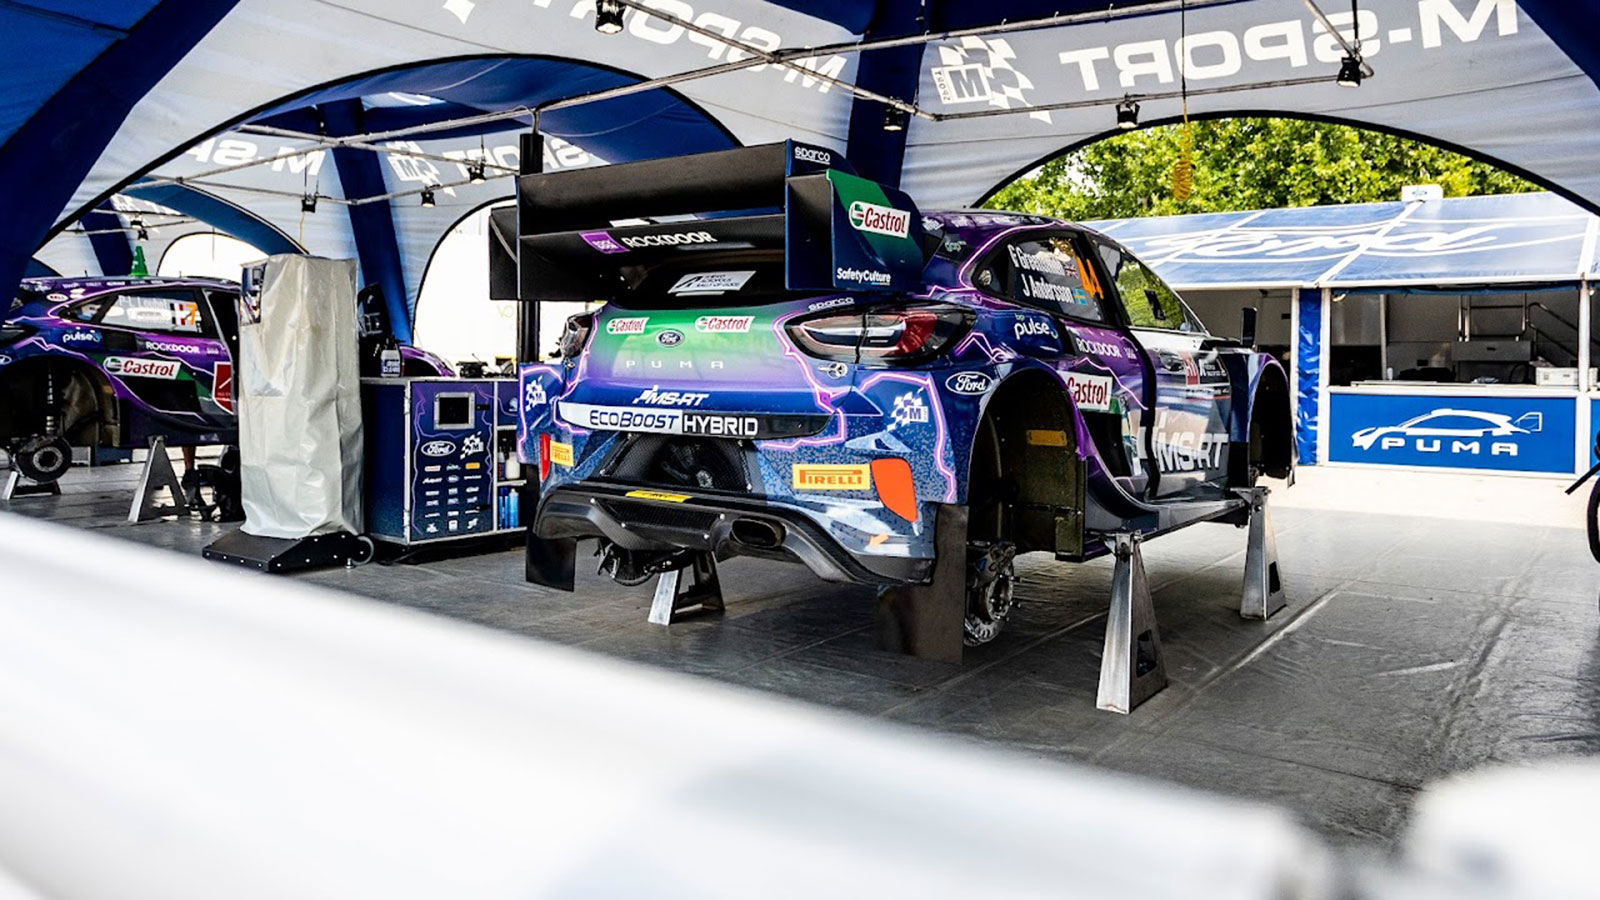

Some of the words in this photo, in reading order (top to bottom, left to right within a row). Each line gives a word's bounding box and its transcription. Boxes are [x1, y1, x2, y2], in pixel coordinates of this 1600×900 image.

[794, 146, 831, 164] sparco
[864, 207, 906, 234] Castrol
[621, 231, 718, 249] ROCKDOOR
[836, 267, 891, 283] SafetyCulture
[1074, 255, 1104, 299] 44
[1021, 273, 1031, 297] J
[185, 302, 198, 325] 7
[808, 297, 855, 312] sparco
[614, 318, 646, 332] Castrol
[707, 317, 750, 331] Castrol
[1014, 318, 1050, 340] pulse
[63, 331, 92, 342] pulse
[145, 341, 200, 354] ROCKDOOR
[1076, 337, 1122, 358] ROCKDOOR
[123, 360, 175, 377] Castrol
[626, 360, 724, 370] PUMA
[955, 374, 987, 392] Ford
[1067, 376, 1109, 405] Castrol
[683, 414, 759, 437] HYBRID
[1381, 437, 1519, 457] PUMA
[799, 469, 863, 485] PIRELLI
